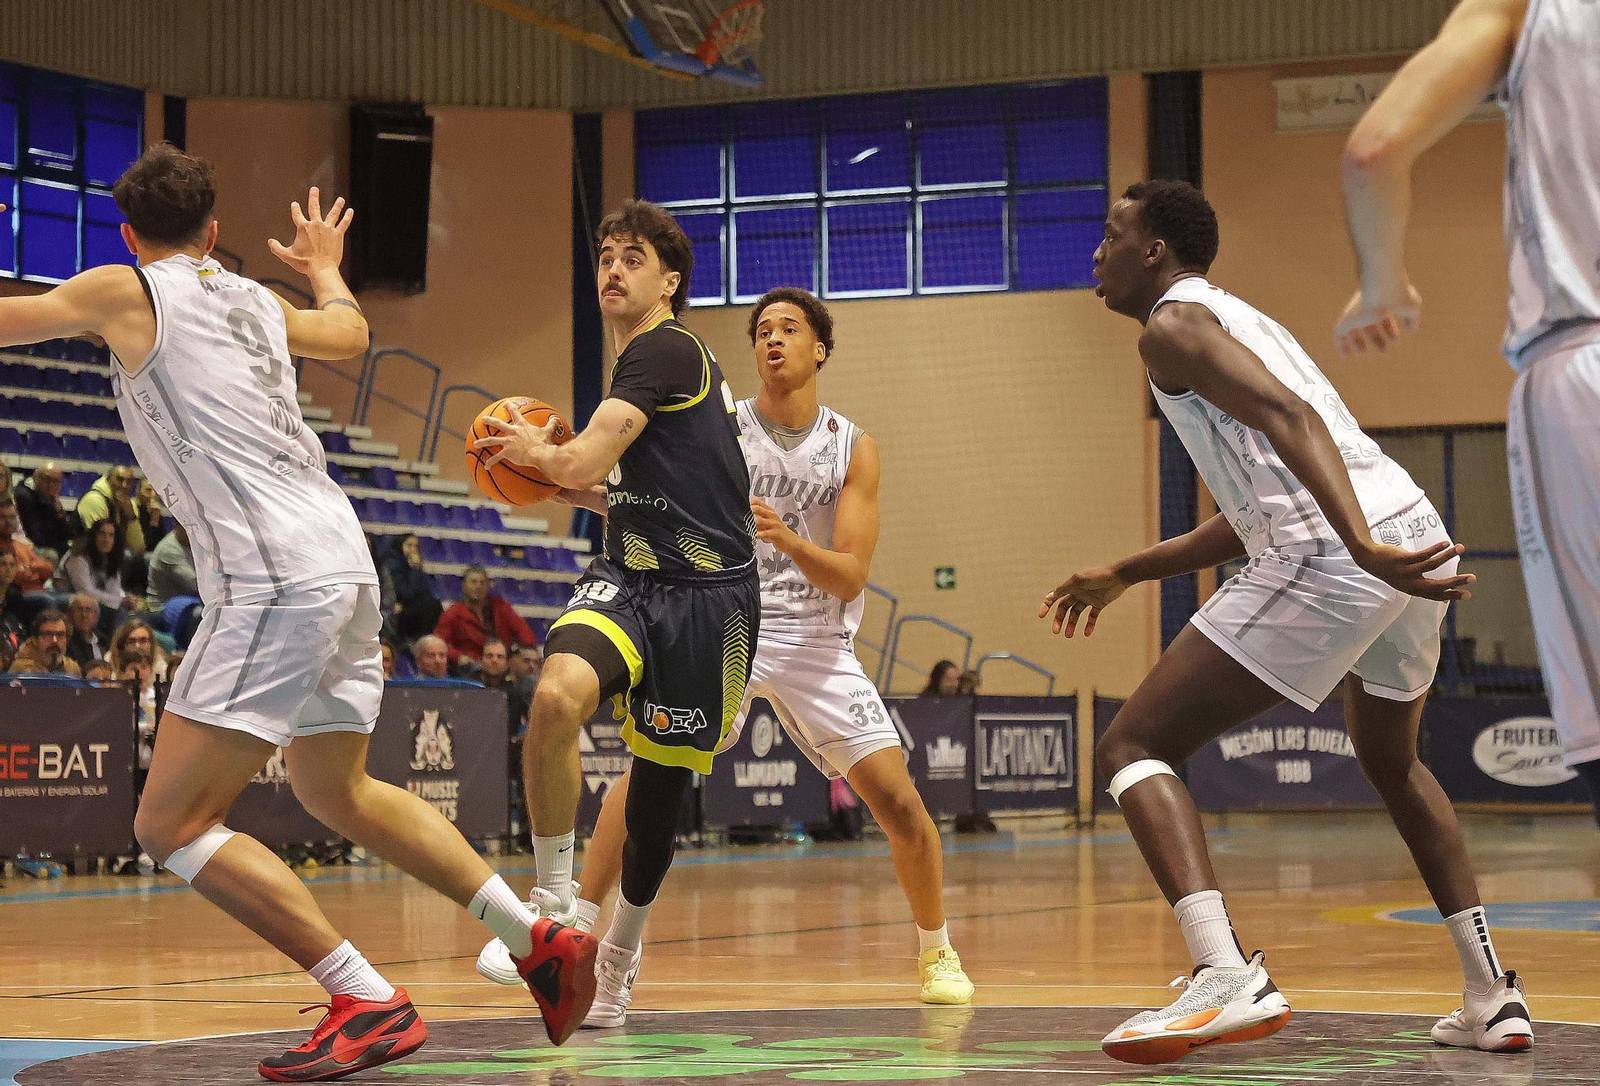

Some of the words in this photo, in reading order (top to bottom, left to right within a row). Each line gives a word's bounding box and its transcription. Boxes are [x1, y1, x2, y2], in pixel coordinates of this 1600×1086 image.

[227, 308, 282, 389] 9
[848, 688, 872, 699] vive
[848, 701, 885, 728] 33
